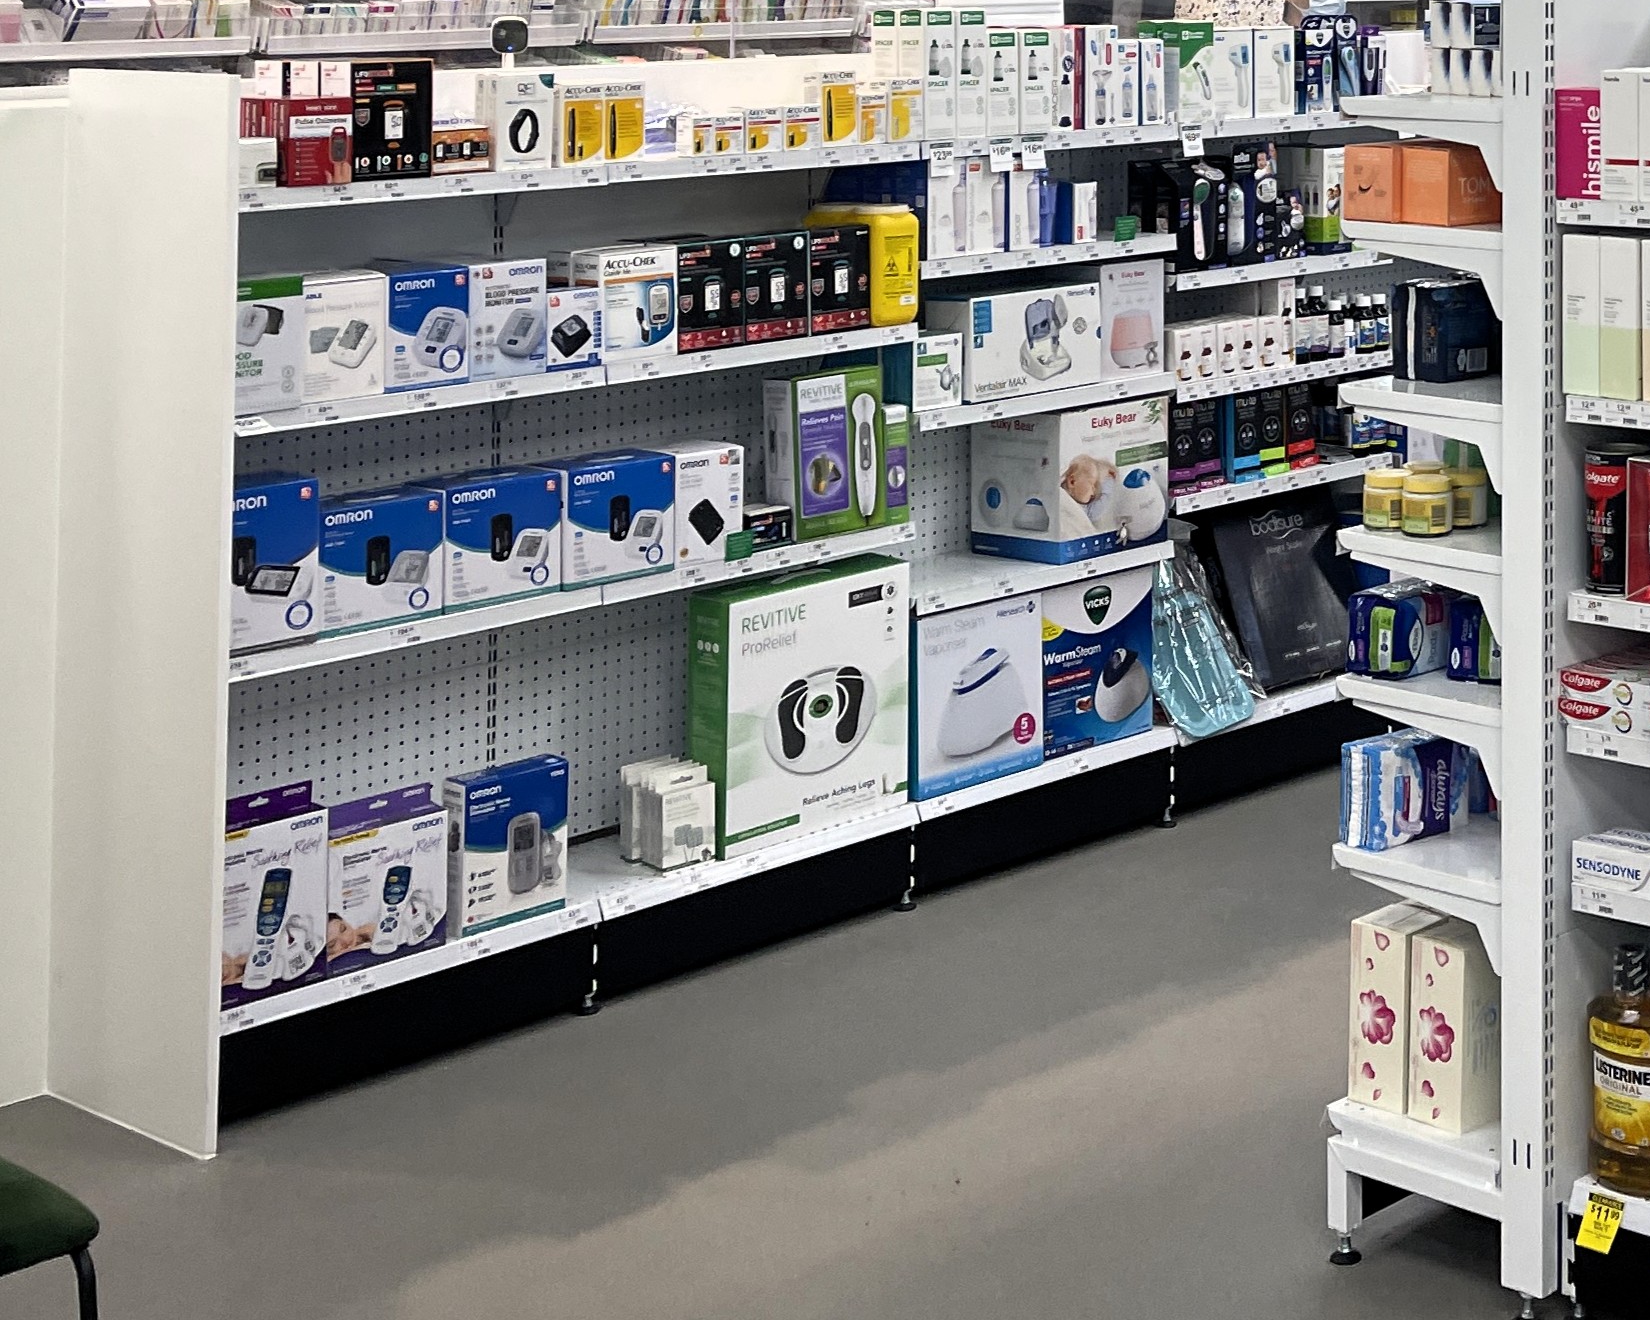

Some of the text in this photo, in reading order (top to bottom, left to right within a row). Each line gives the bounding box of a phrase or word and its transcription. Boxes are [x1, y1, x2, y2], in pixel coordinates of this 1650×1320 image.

[1581, 105, 1600, 196] hismile
[509, 265, 543, 276] OMRON
[604, 256, 656, 270] ACCU-CHEK
[394, 278, 436, 292] OMRON
[800, 384, 843, 401] REVITIVE
[1091, 411, 1137, 429] Euky Bear
[680, 458, 709, 469] OMRON
[574, 470, 615, 486] OMRON
[452, 488, 496, 504] OMRON
[325, 509, 373, 526] OMRON
[1085, 594, 1110, 609] VICKS
[742, 604, 806, 634] REVITIVE
[741, 630, 797, 656] ProRelief
[1562, 672, 1600, 689] Colgate
[1560, 699, 1600, 716] Colgate
[1020, 717, 1029, 730] 5
[469, 785, 502, 800] OMRON
[1435, 759, 1451, 821] always
[290, 816, 323, 831] OMRON
[412, 817, 443, 832] OMRON
[1575, 857, 1641, 882] SENSODYNE
[1600, 1074, 1642, 1096] ORIGINAL
